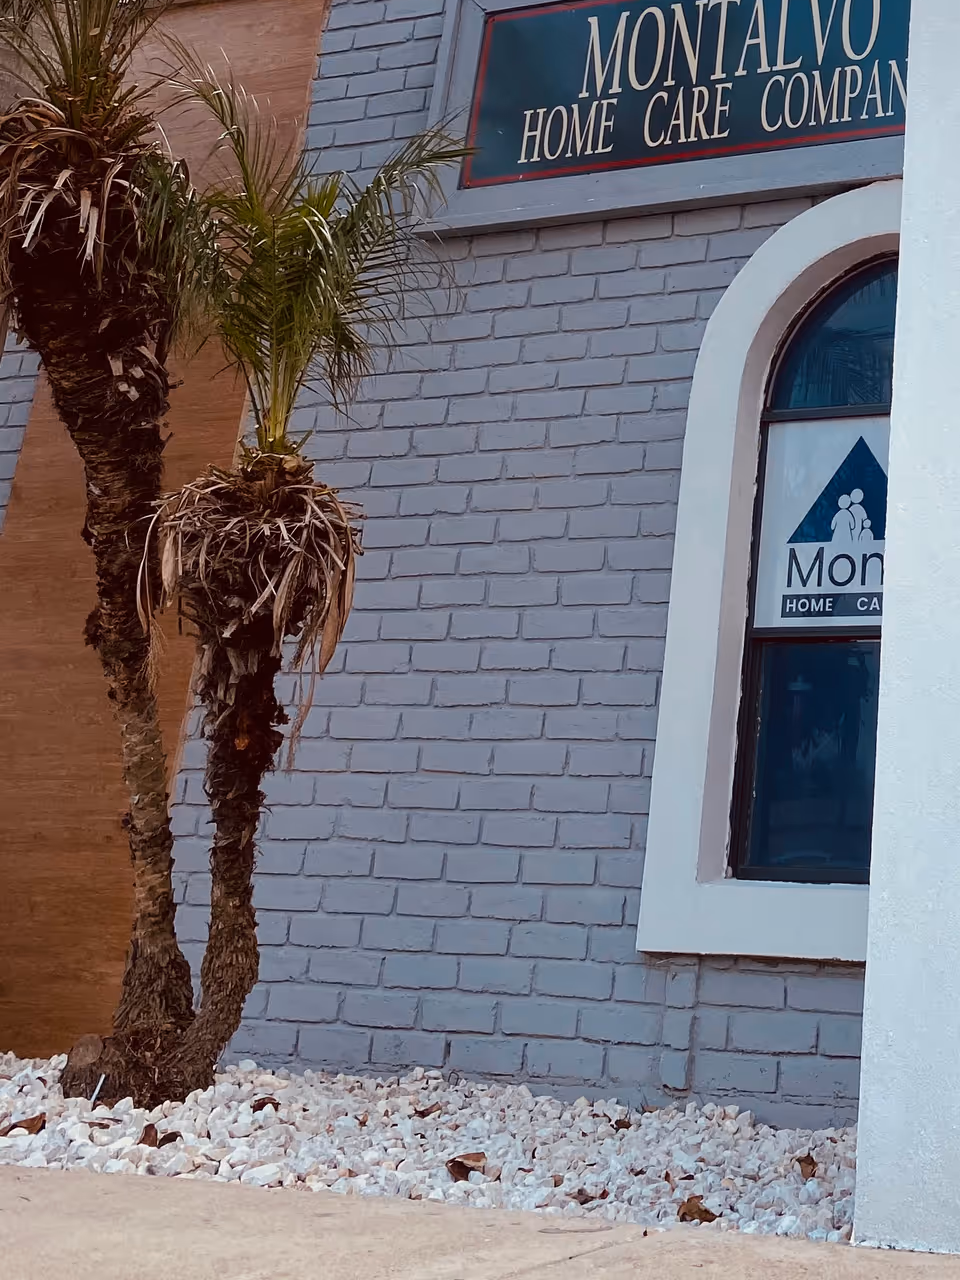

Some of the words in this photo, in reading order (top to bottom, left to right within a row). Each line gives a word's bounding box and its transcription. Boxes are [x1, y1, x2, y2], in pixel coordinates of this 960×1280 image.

[517, 98, 617, 164] HOME
[643, 83, 732, 148] CARE
[786, 598, 833, 612] HOME
[857, 596, 880, 611] CA
